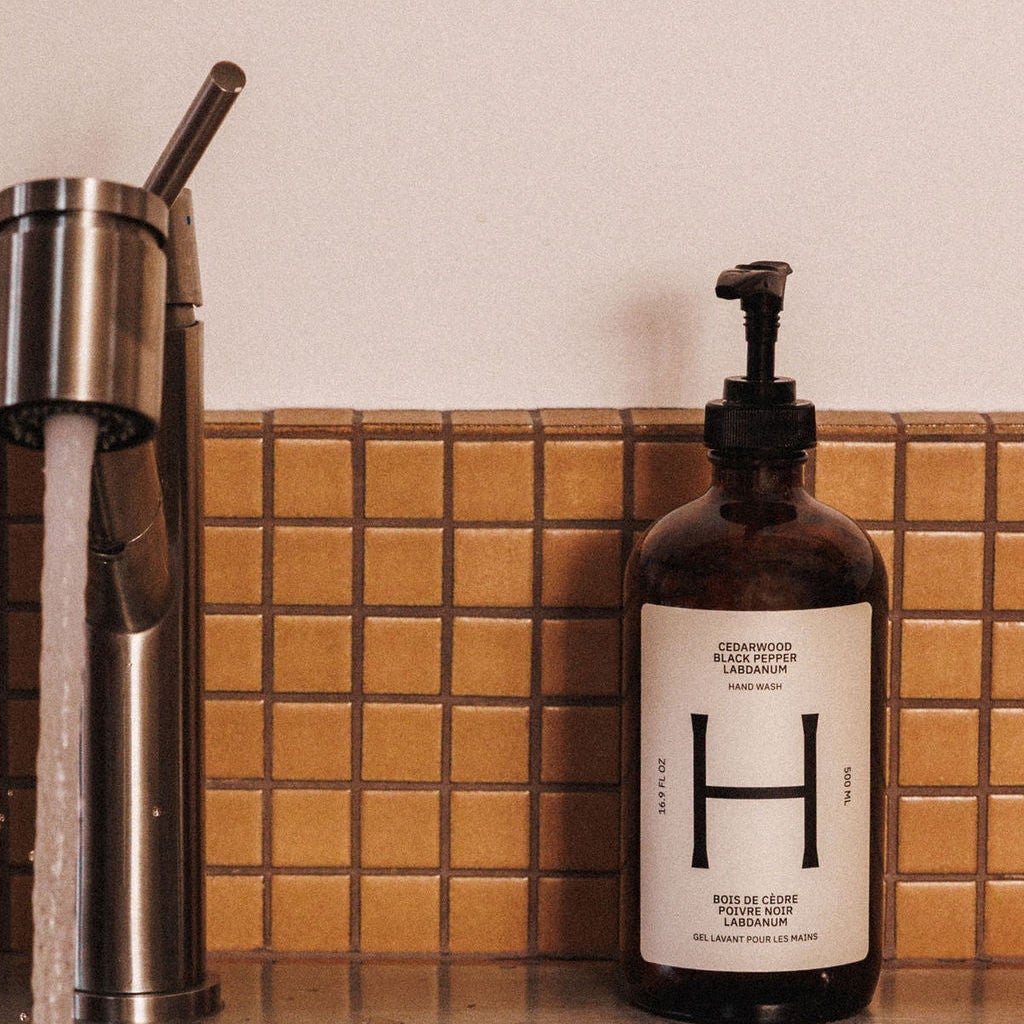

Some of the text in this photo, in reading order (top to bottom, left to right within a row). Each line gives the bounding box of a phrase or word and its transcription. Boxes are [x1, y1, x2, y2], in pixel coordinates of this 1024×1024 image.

[718, 642, 792, 652] CEDARWOOD
[713, 653, 797, 663] BLACK PEPPER
[723, 664, 788, 675] LABDANUM
[728, 683, 783, 691] HAND WASH
[658, 758, 666, 815] 16.9 FL OZ
[690, 713, 820, 869] H
[843, 766, 852, 807] 500 ML
[713, 893, 798, 905] BOIS DE CÈDRE
[718, 905, 794, 916] POIVRE NOIR
[723, 917, 788, 927] LABDANUM
[692, 932, 818, 944] GEL LAVANT POUR LES MAINS
